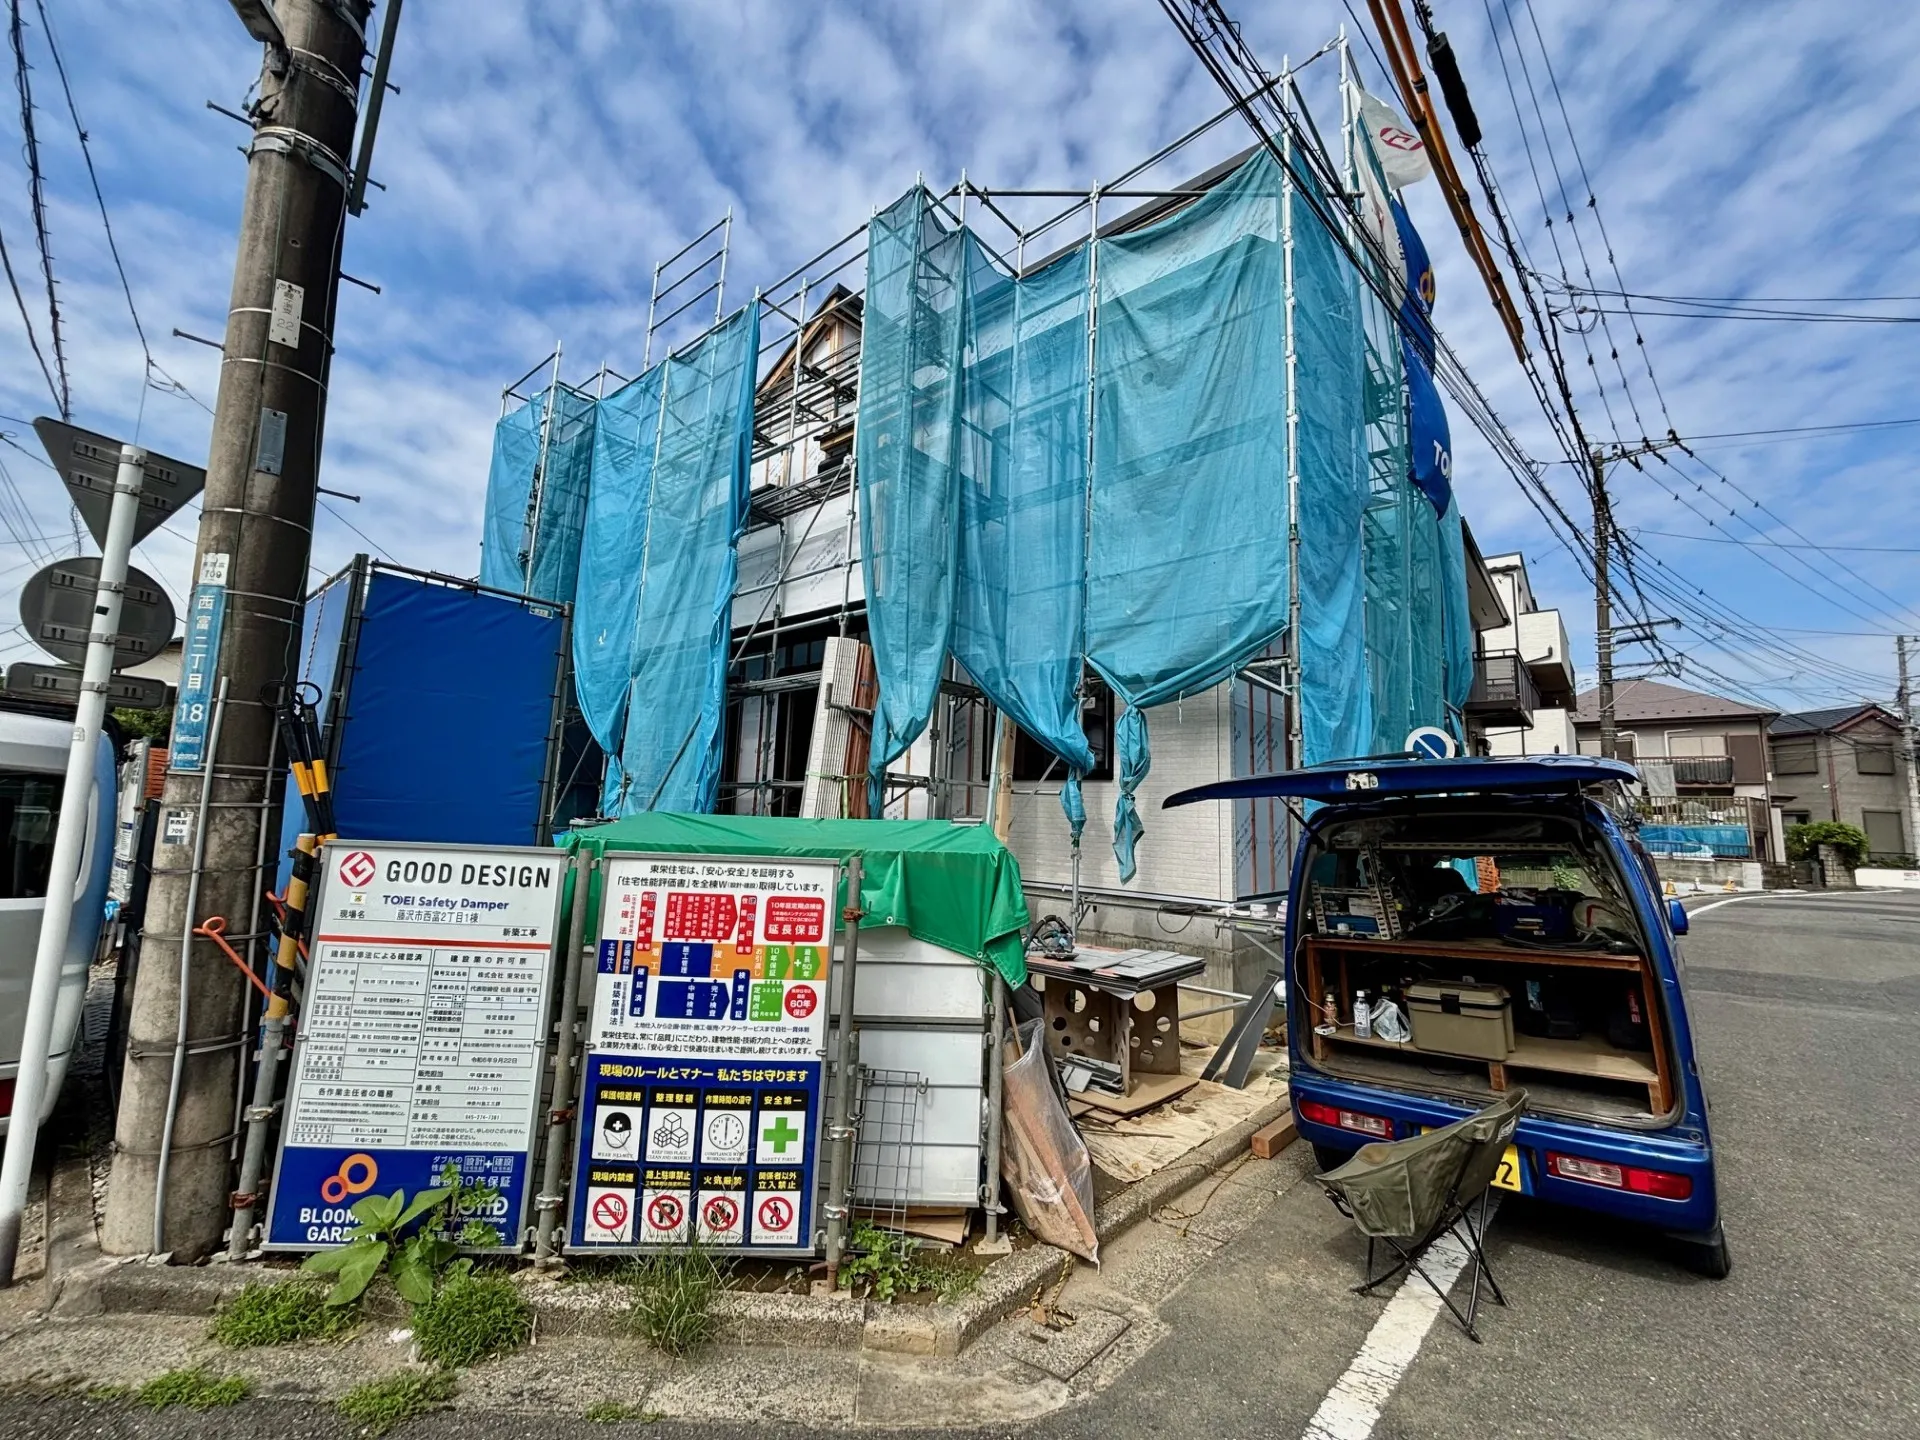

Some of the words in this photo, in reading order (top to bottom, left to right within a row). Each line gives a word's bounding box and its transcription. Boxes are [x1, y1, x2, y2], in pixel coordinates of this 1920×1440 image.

[1433, 439, 1452, 481] TO
[187, 595, 215, 688] 西富二丁目
[181, 703, 204, 722] 18
[386, 859, 453, 884] GOOD
[461, 864, 551, 888] DESIGN
[650, 864, 794, 879] 東栄住宅は、「安心・安全」を証明する
[418, 896, 458, 910] Safety
[460, 898, 509, 912] Damper
[339, 909, 366, 919] 現場名
[396, 910, 480, 924] 藤沢市西富2丁目1棟
[502, 927, 538, 938] 新築工事
[768, 924, 819, 936] 延長保証
[450, 954, 527, 965] 建設業の許可票
[606, 942, 616, 971] 土地仕入
[735, 971, 746, 1019] 検査済証
[609, 981, 622, 1026] 建築基準法
[685, 985, 695, 1017] 中間検査
[708, 985, 719, 1017] 完了検査
[751, 986, 761, 1019] 定期点検
[789, 1000, 812, 1009] 60年
[793, 1009, 807, 1017] 保証
[599, 1064, 713, 1080] 現場のルールとマナー
[717, 1068, 809, 1082] 私たちは守ります
[318, 1087, 394, 1098] 各作業主任者の職務
[600, 1090, 641, 1101] 保護帽着用
[655, 1093, 694, 1103] 整理整頓
[705, 1094, 752, 1105] 作業時間の遵守
[763, 1096, 802, 1105] 安全第一
[466, 1157, 483, 1166] 設計
[494, 1157, 512, 1166] 建設
[592, 1171, 634, 1183] 現場内禁煙
[645, 1170, 691, 1180] 路上駐車禁止
[703, 1175, 743, 1185] 火気厳禁
[758, 1171, 796, 1181] 関係者以外
[757, 1180, 796, 1190] 立入禁止
